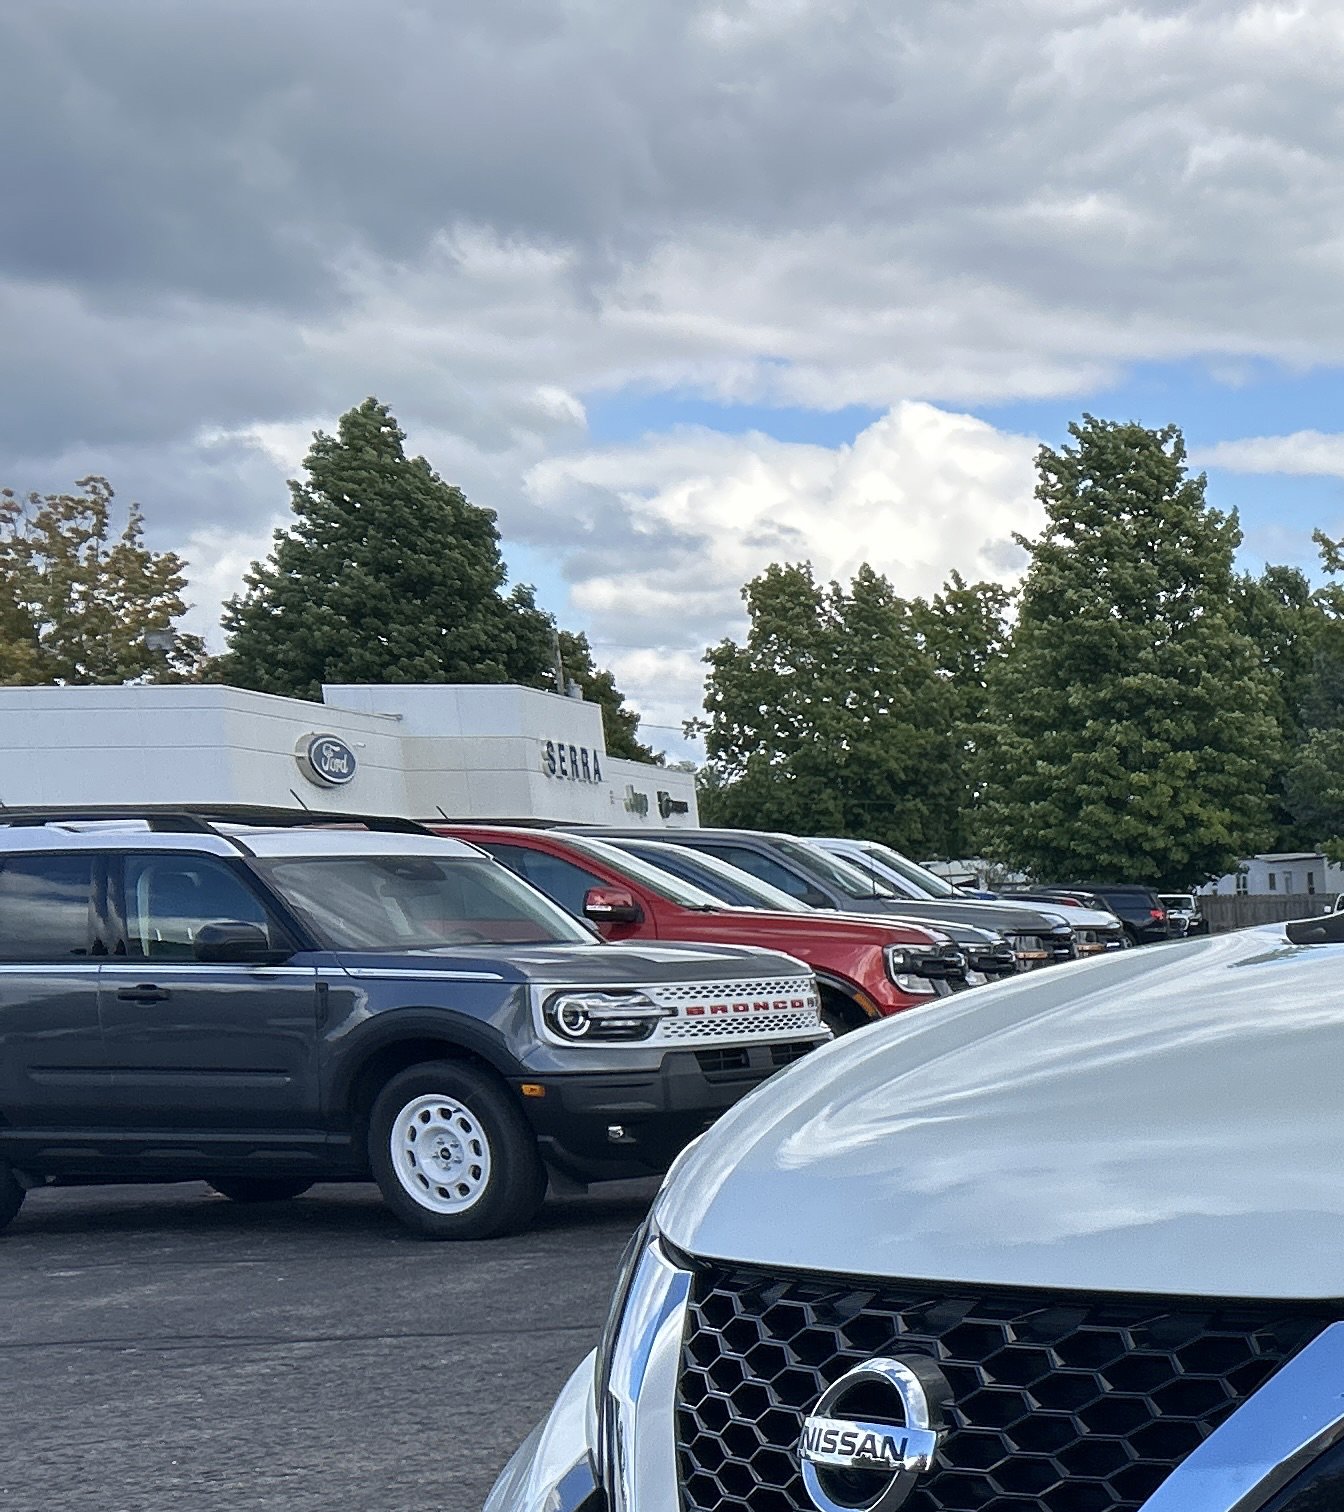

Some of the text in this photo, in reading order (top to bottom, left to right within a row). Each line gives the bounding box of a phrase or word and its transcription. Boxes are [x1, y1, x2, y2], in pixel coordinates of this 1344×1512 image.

[322, 743, 348, 773] Ford
[545, 741, 602, 782] SERRA
[686, 1000, 804, 1016] BRONCO
[802, 1425, 908, 1461] NISSAN
